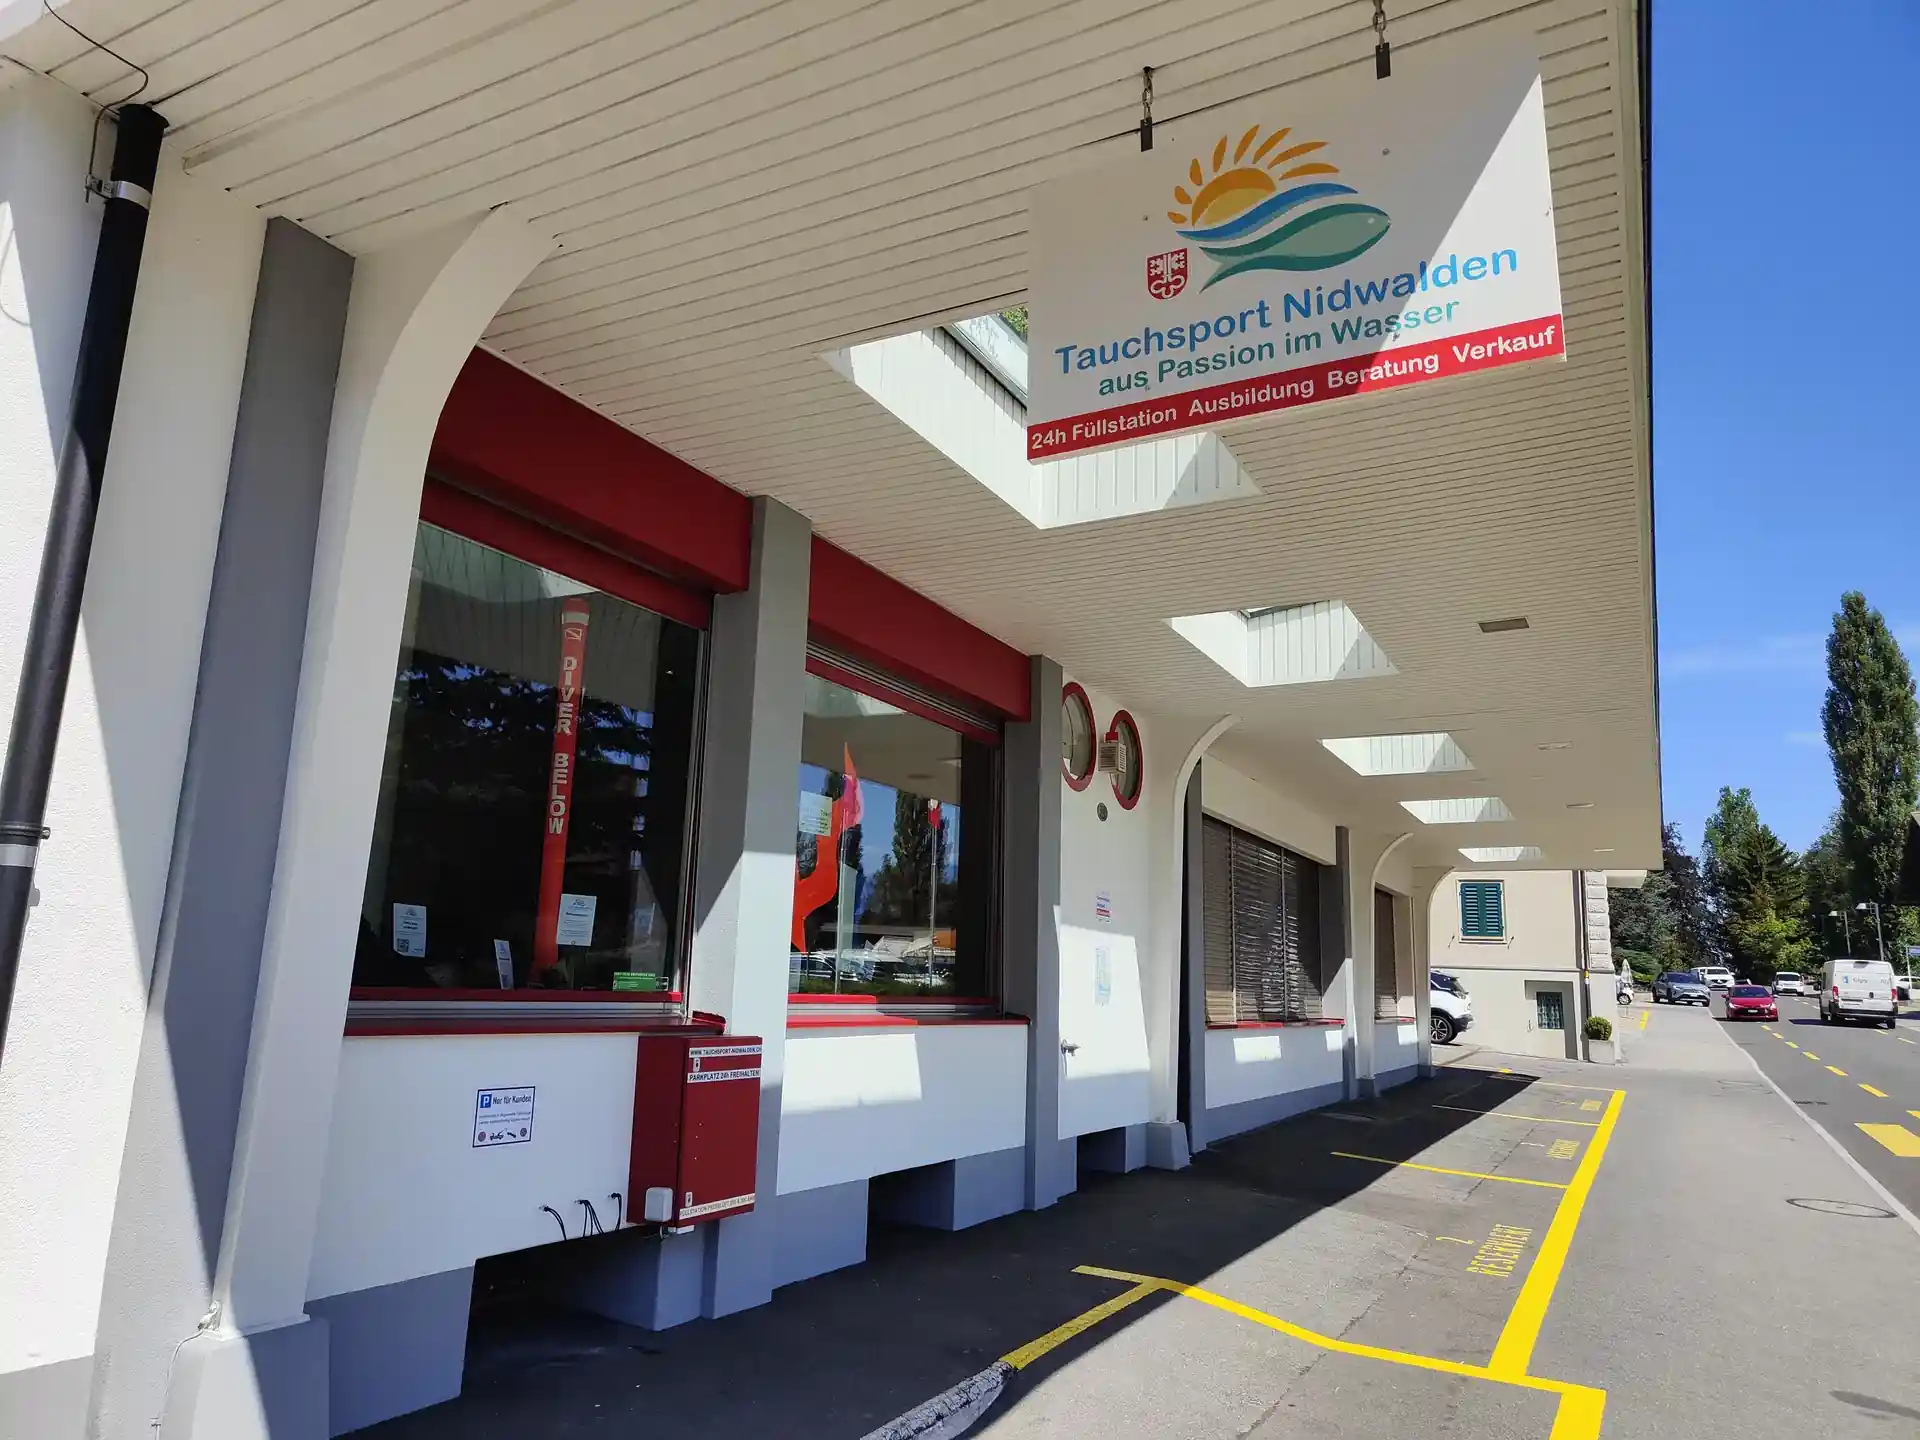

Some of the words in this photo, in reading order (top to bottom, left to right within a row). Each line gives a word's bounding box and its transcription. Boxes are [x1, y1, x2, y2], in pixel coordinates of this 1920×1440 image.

[1055, 299, 1273, 375] Tauchsport
[1283, 248, 1518, 318] Nidwalden
[1098, 370, 1149, 396] aus
[1157, 340, 1275, 384] Passion
[1284, 331, 1322, 356] im
[1330, 300, 1460, 346] Wasser
[1031, 428, 1067, 451] 24h
[1072, 405, 1178, 442] Füllstation
[1188, 377, 1315, 418] Ausbildung
[1327, 350, 1440, 391] Beratung
[1451, 325, 1556, 365] Verkauf
[556, 656, 578, 736] DIVER
[548, 752, 569, 835] BELOW
[492, 1097, 502, 1105] Nur
[503, 1096, 511, 1104] für
[512, 1094, 531, 1103] Kunden
[689, 1073, 720, 1081] PARKPLATZ
